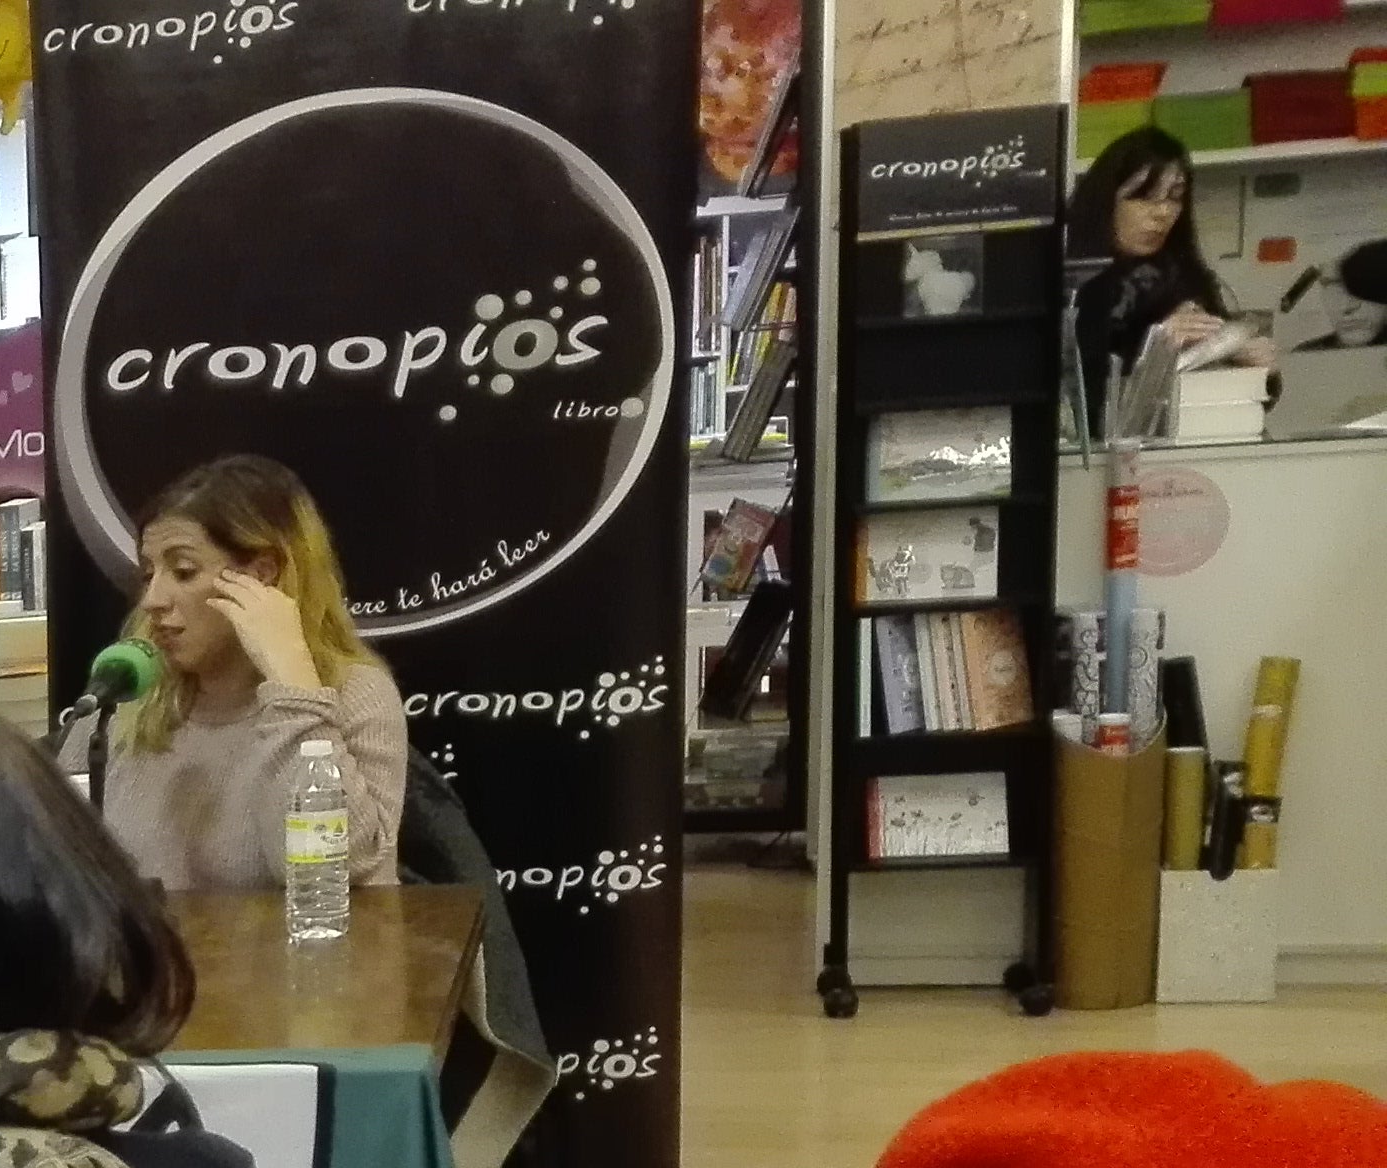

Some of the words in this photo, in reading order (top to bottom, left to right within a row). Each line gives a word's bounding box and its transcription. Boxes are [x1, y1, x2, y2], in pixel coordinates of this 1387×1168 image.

[44, 1, 299, 55] cronopios
[871, 146, 1026, 179] cronopios
[107, 296, 609, 398] cronopios
[398, 587, 423, 609] te
[431, 558, 498, 600] hará
[497, 529, 551, 567] leer
[405, 673, 669, 727] cronopios
